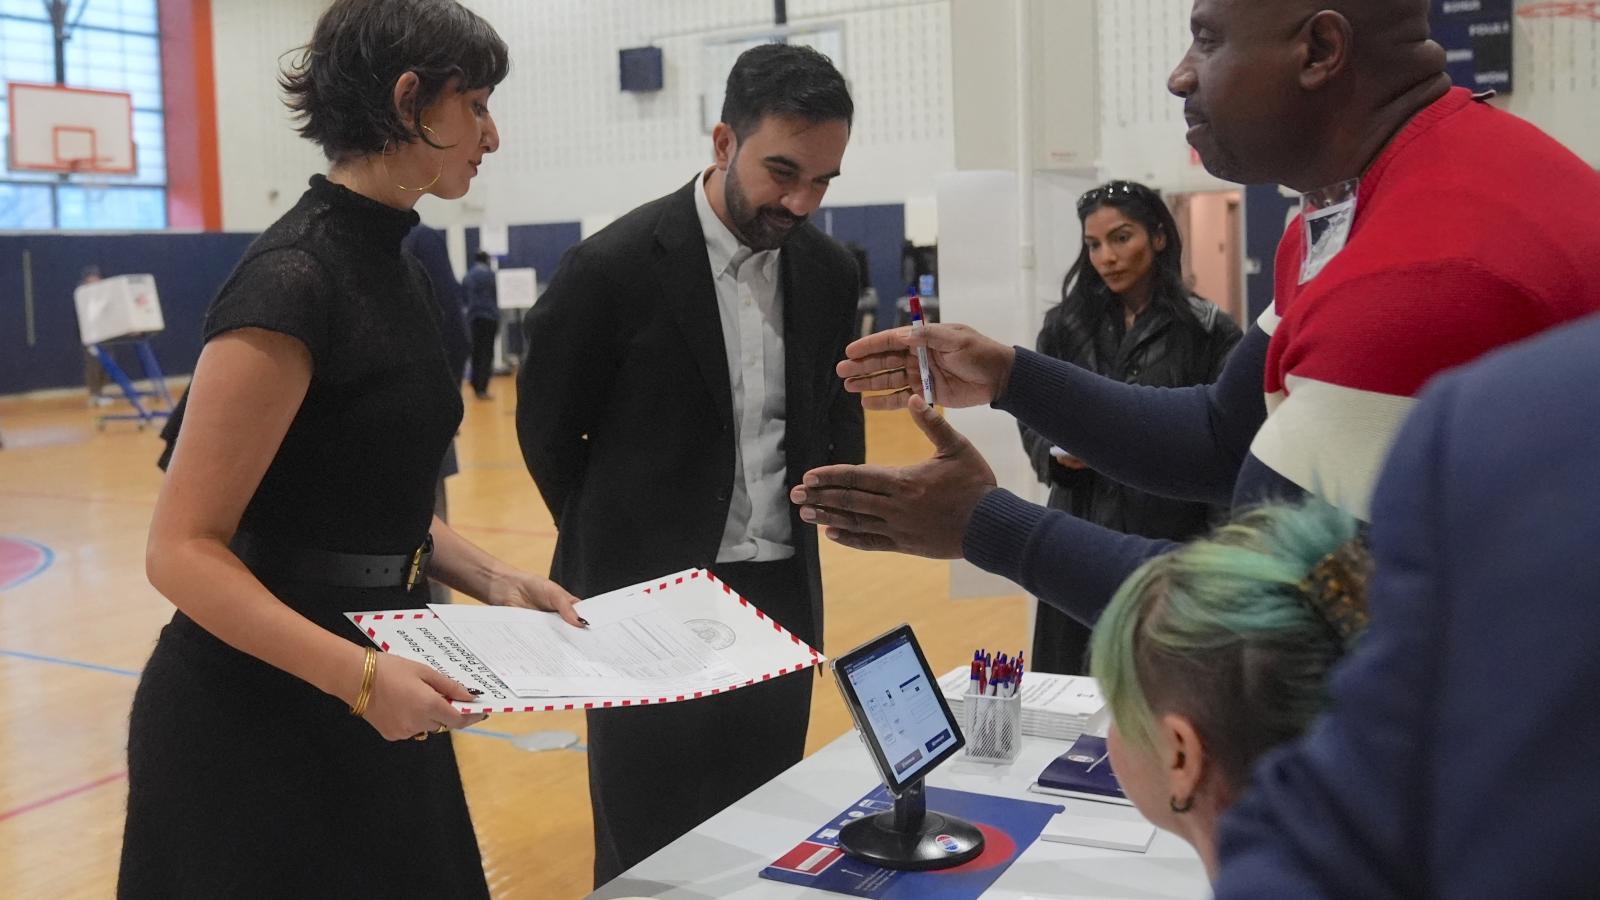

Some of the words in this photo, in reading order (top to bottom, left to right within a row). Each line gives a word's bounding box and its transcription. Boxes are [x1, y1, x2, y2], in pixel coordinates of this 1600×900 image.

[397, 629, 425, 653] Sleeve
[416, 625, 462, 663] Privacidad
[443, 635, 480, 665] Papeleta
[459, 663, 473, 673] de
[477, 665, 488, 676] la
[470, 673, 507, 700] Carpeta
[487, 673, 509, 689] para
